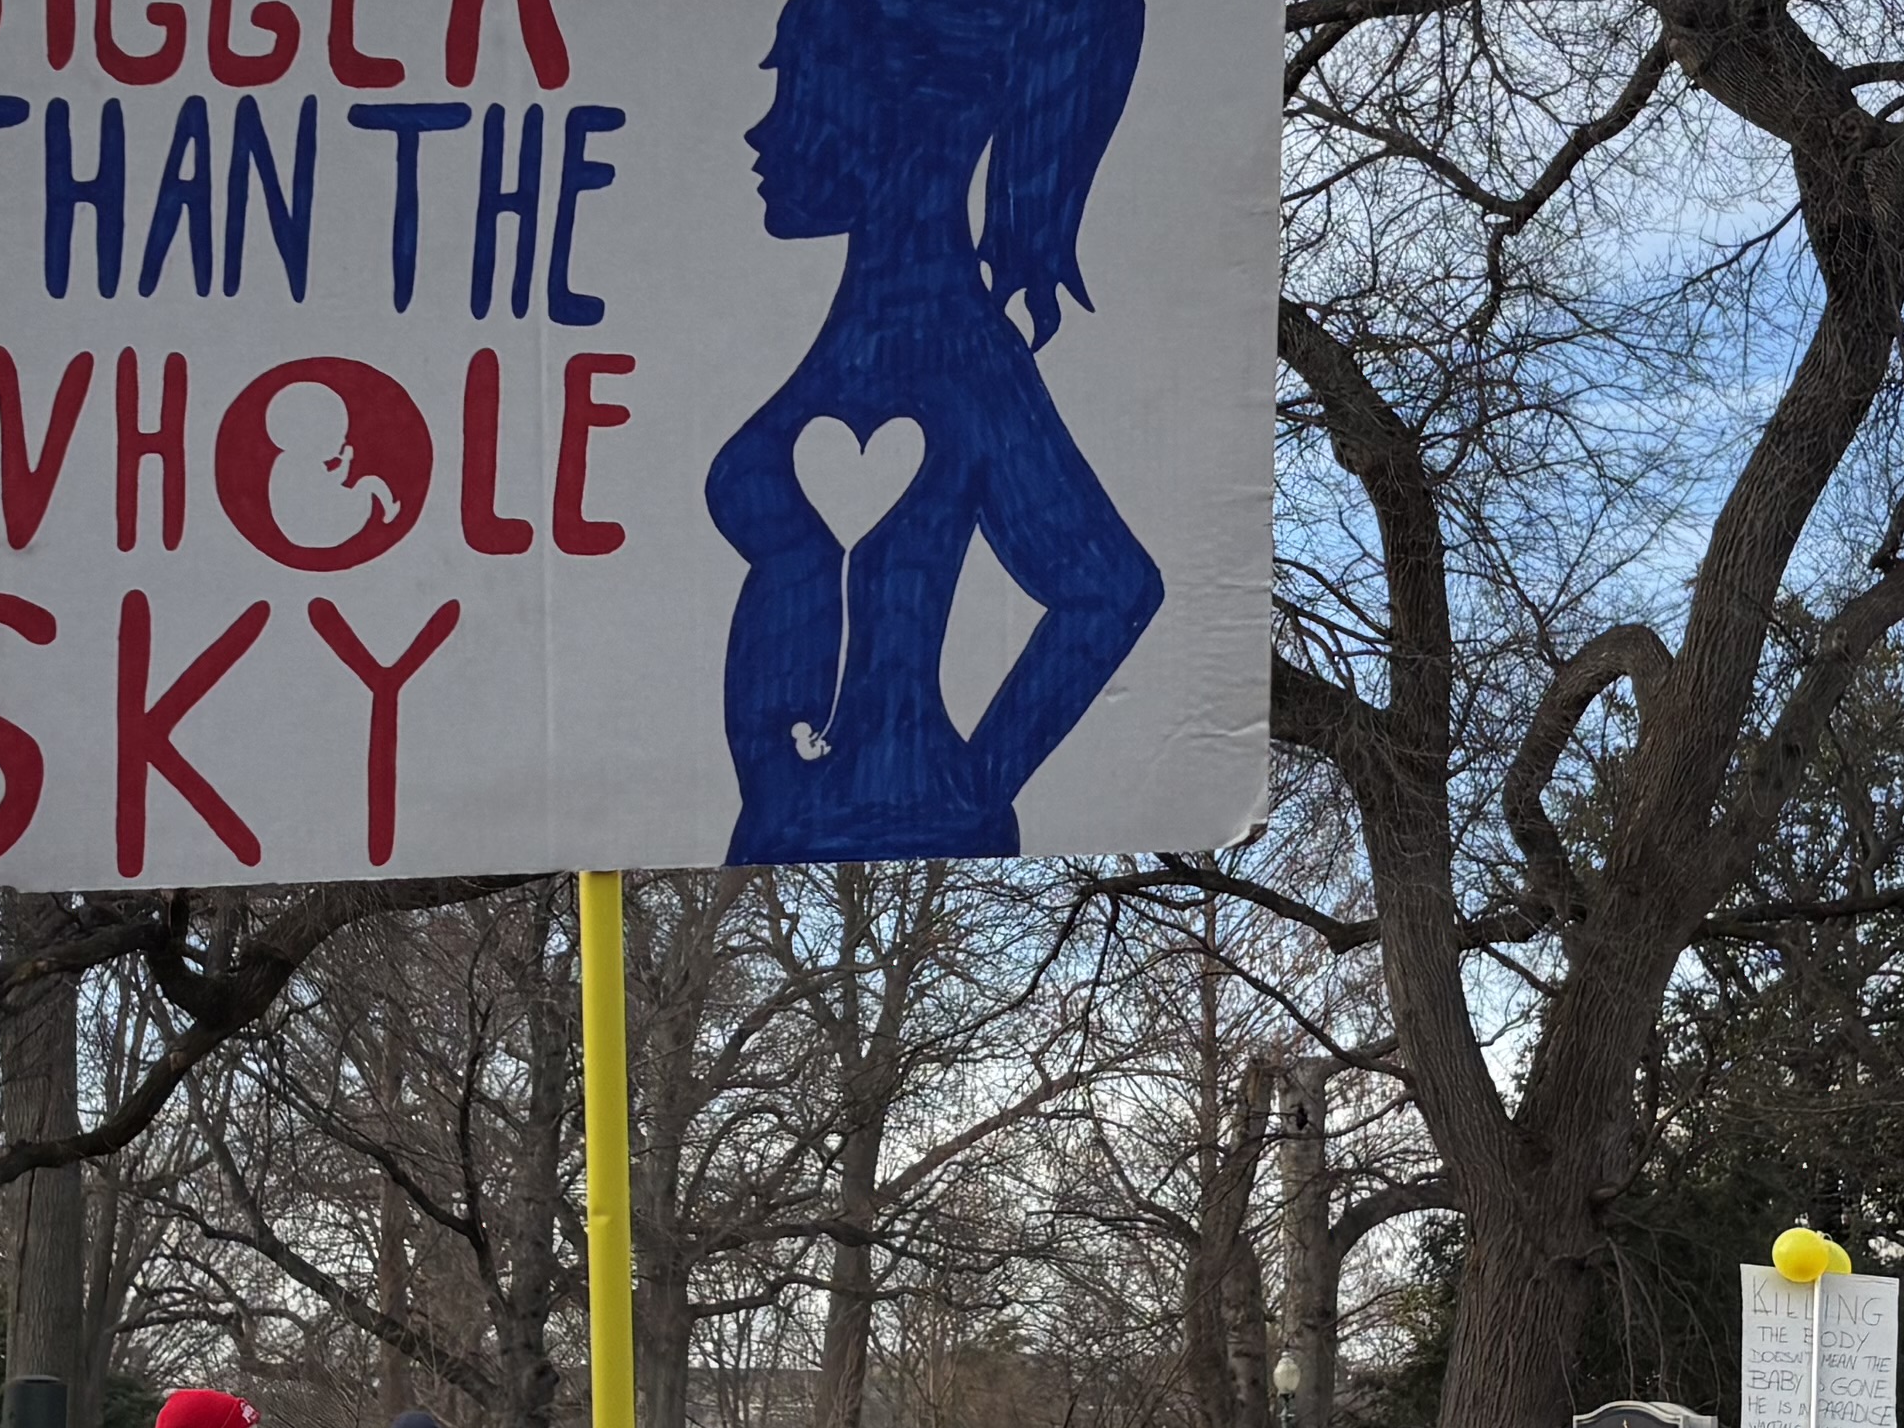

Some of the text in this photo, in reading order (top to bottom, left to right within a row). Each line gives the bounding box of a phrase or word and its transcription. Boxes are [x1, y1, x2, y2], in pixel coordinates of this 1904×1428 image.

[348, 102, 627, 326] THE
[1752, 1276, 1884, 1326] KILLING
[1757, 1326, 1788, 1343] THE
[1820, 1354, 1856, 1370] MEAN
[1861, 1356, 1891, 1373] THE
[1747, 1370, 1804, 1394] BABY
[1748, 1395, 1767, 1414] HE
[1778, 1402, 1792, 1415] IS
[1818, 1398, 1895, 1427] PARADISE
